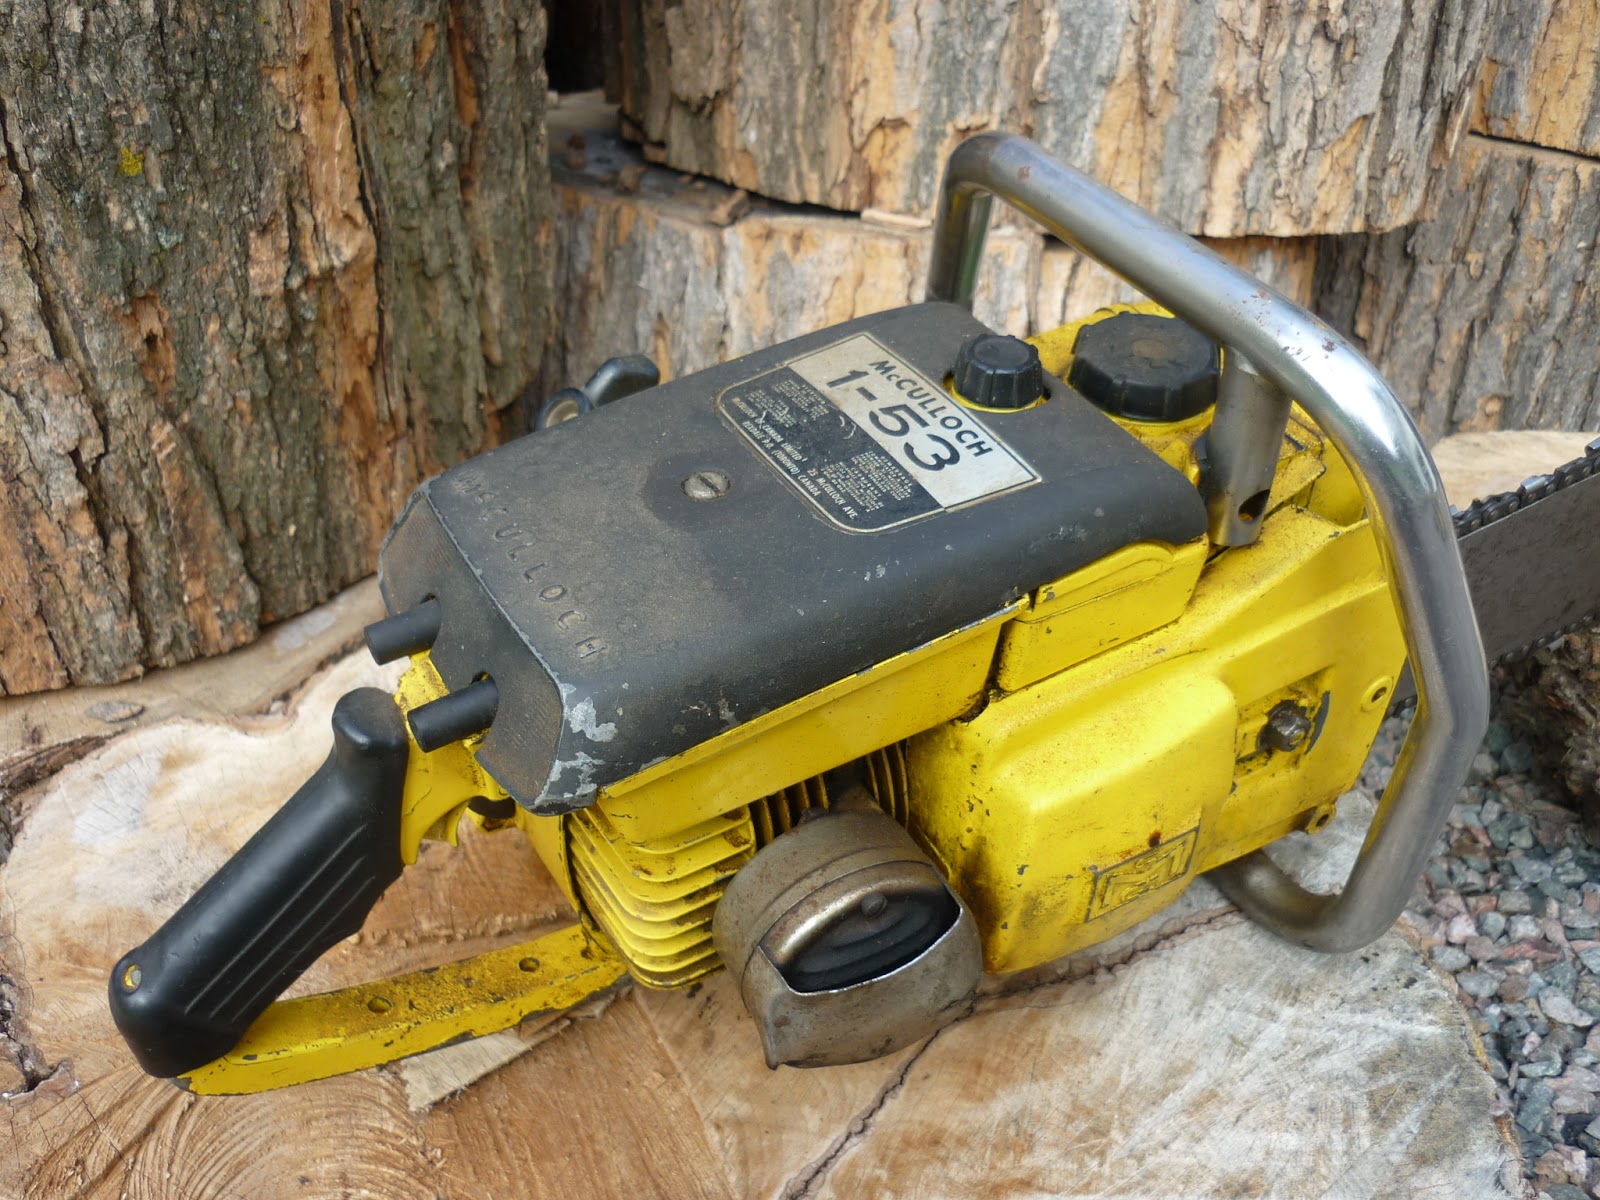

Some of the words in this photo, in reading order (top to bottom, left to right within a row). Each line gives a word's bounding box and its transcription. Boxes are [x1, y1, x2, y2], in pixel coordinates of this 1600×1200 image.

[828, 371, 960, 470] 1-53
[871, 361, 992, 456] McCULLOCH
[761, 424, 784, 442] CANADA
[805, 468, 819, 476] 25
[812, 477, 847, 505] McCULLOCH
[841, 505, 861, 519] AVE.
[770, 449, 801, 475] (TORONTO)
[796, 475, 822, 496] CANADA
